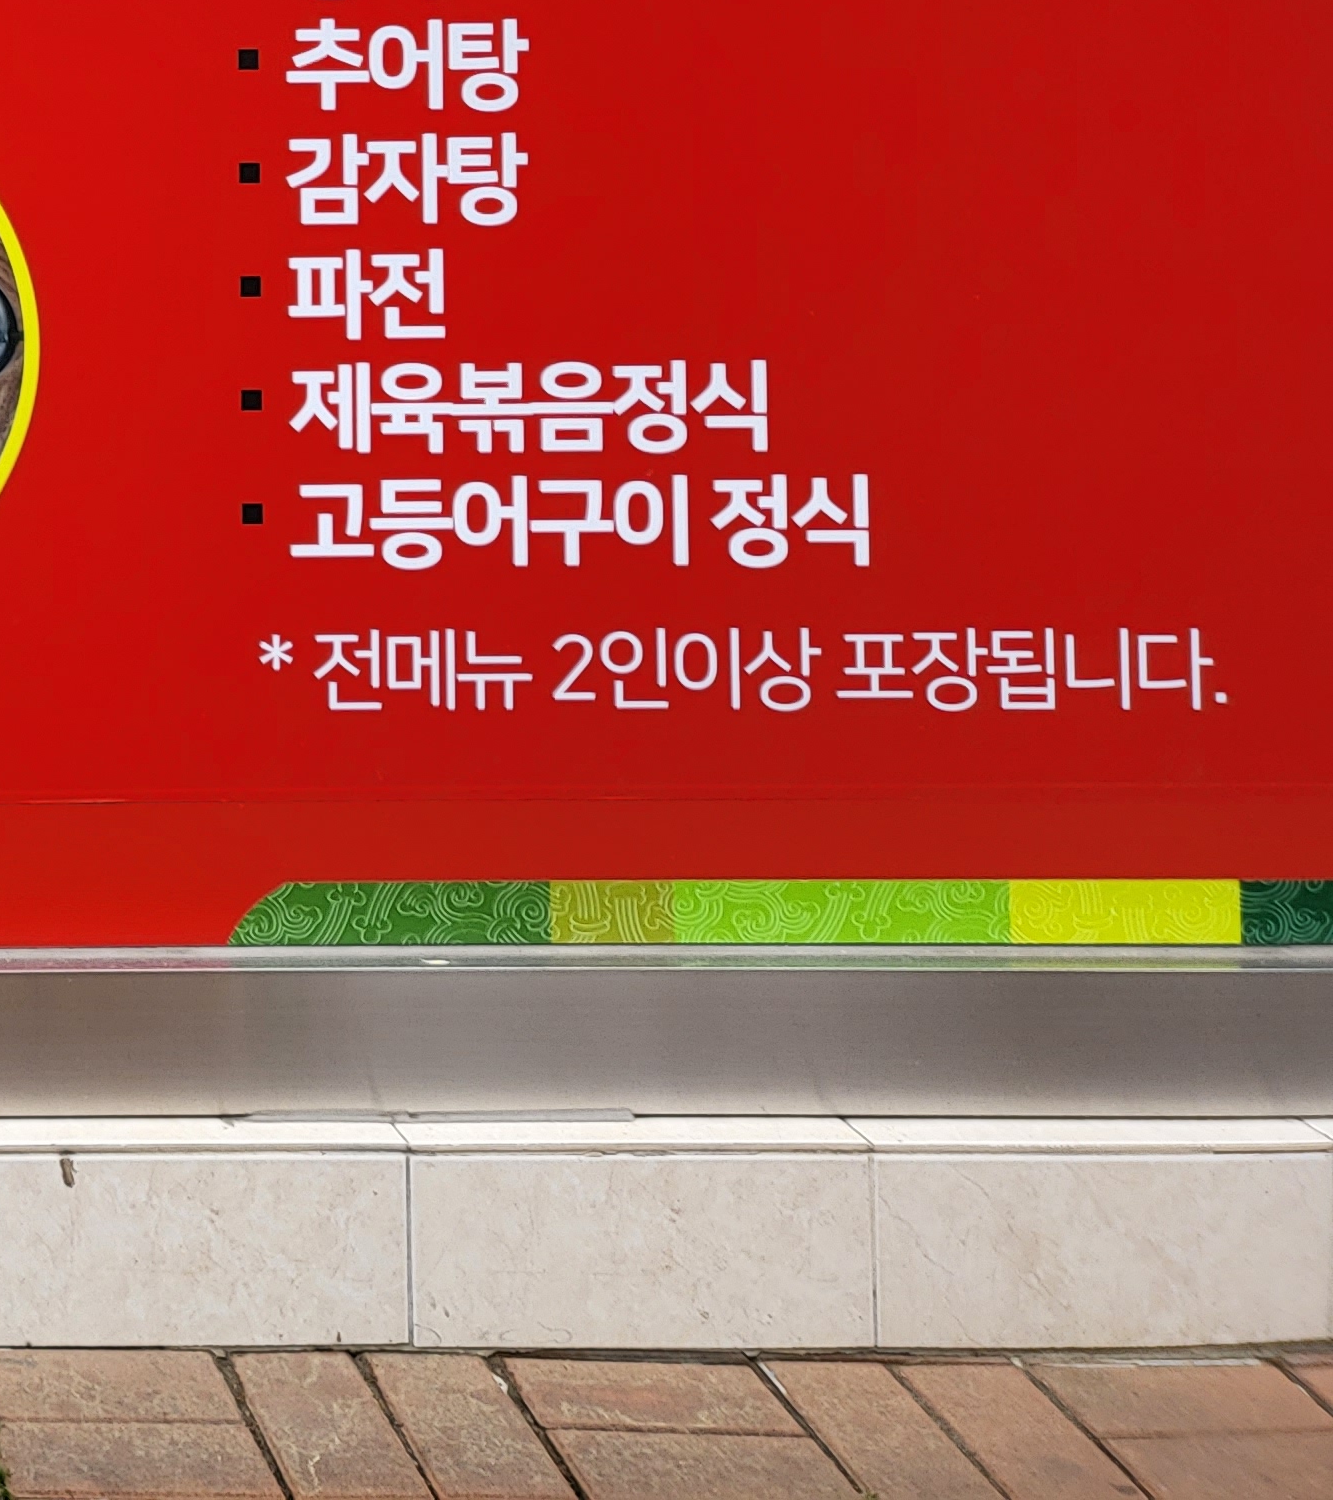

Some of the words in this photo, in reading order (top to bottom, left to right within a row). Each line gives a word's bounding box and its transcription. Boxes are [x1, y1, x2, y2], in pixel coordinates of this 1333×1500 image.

[285, 18, 530, 112] 추어탕
[285, 132, 529, 227] 감자탕
[287, 248, 446, 341] 파전
[289, 359, 769, 454] 제육볶음정식
[290, 474, 690, 570] 고등어구이
[710, 473, 870, 569] 정식
[314, 628, 533, 711] 전메뉴
[552, 627, 822, 712] 2인이상
[836, 627, 1228, 712] 포장됩니다.
